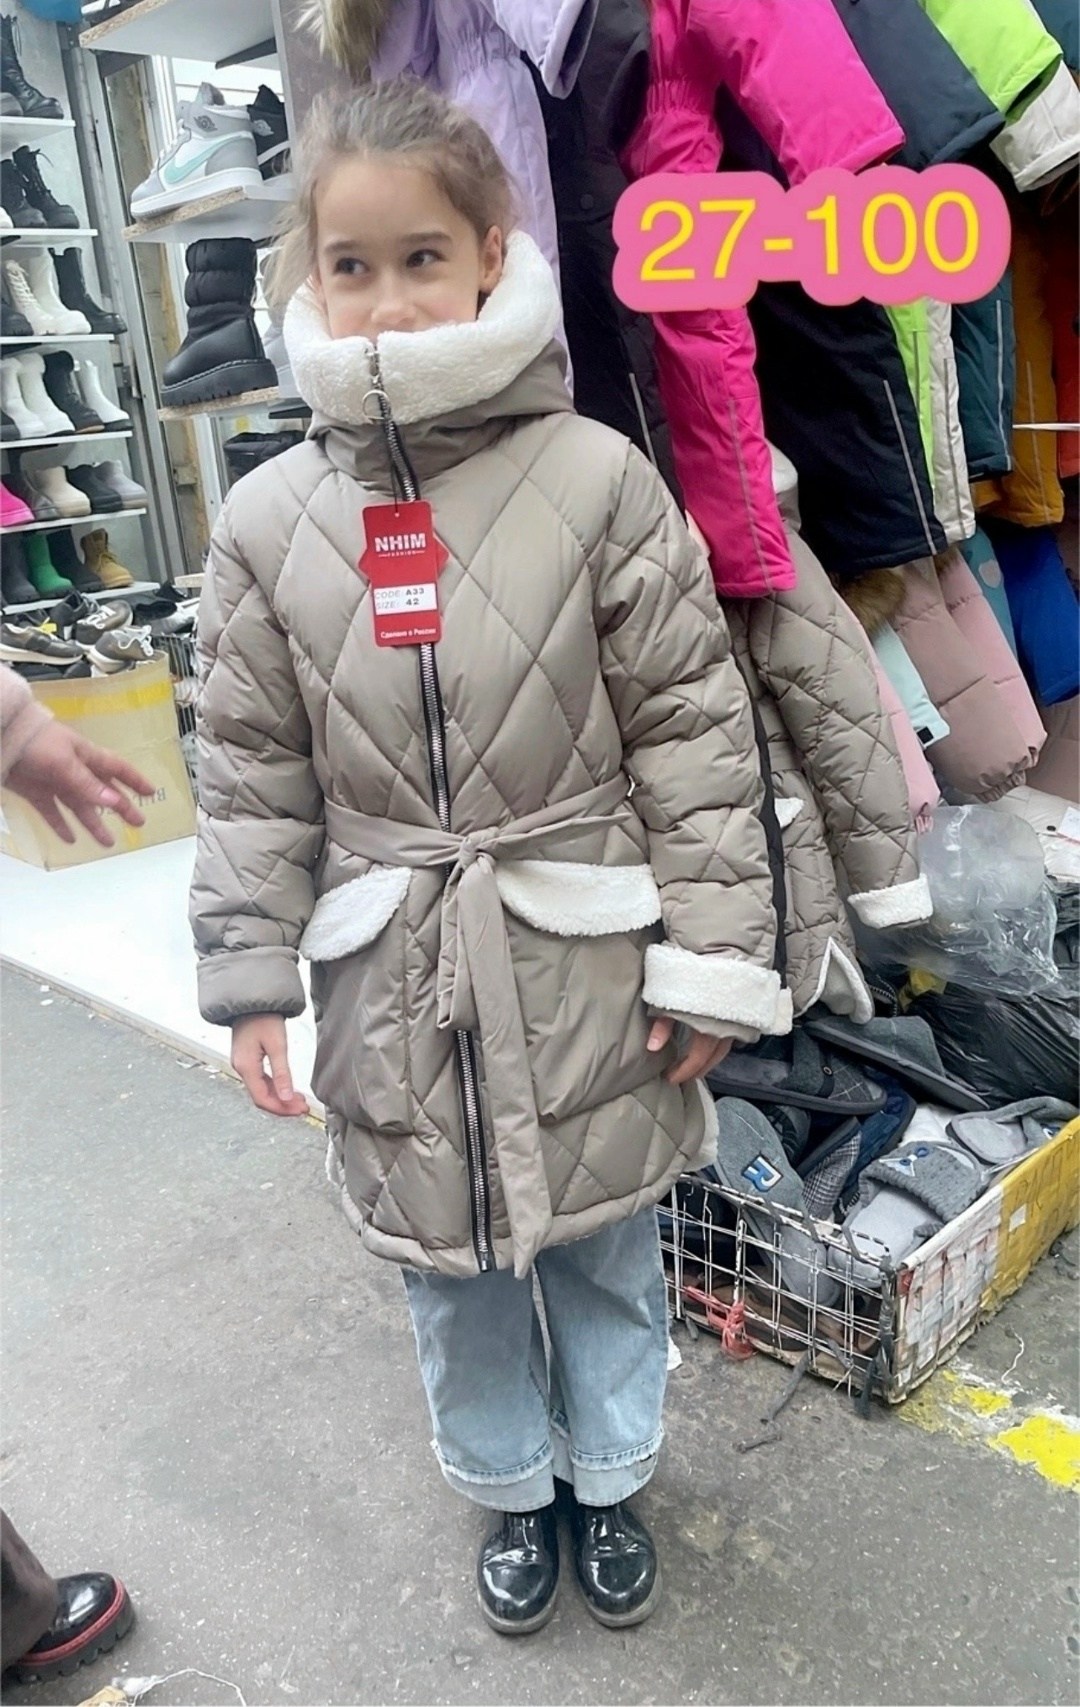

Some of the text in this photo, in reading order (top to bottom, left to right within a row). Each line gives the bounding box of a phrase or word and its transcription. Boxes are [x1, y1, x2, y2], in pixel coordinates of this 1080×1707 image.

[375, 533, 426, 552] NHIM
[405, 587, 425, 596] A33
[406, 598, 420, 606] 42
[741, 1154, 784, 1192] R
